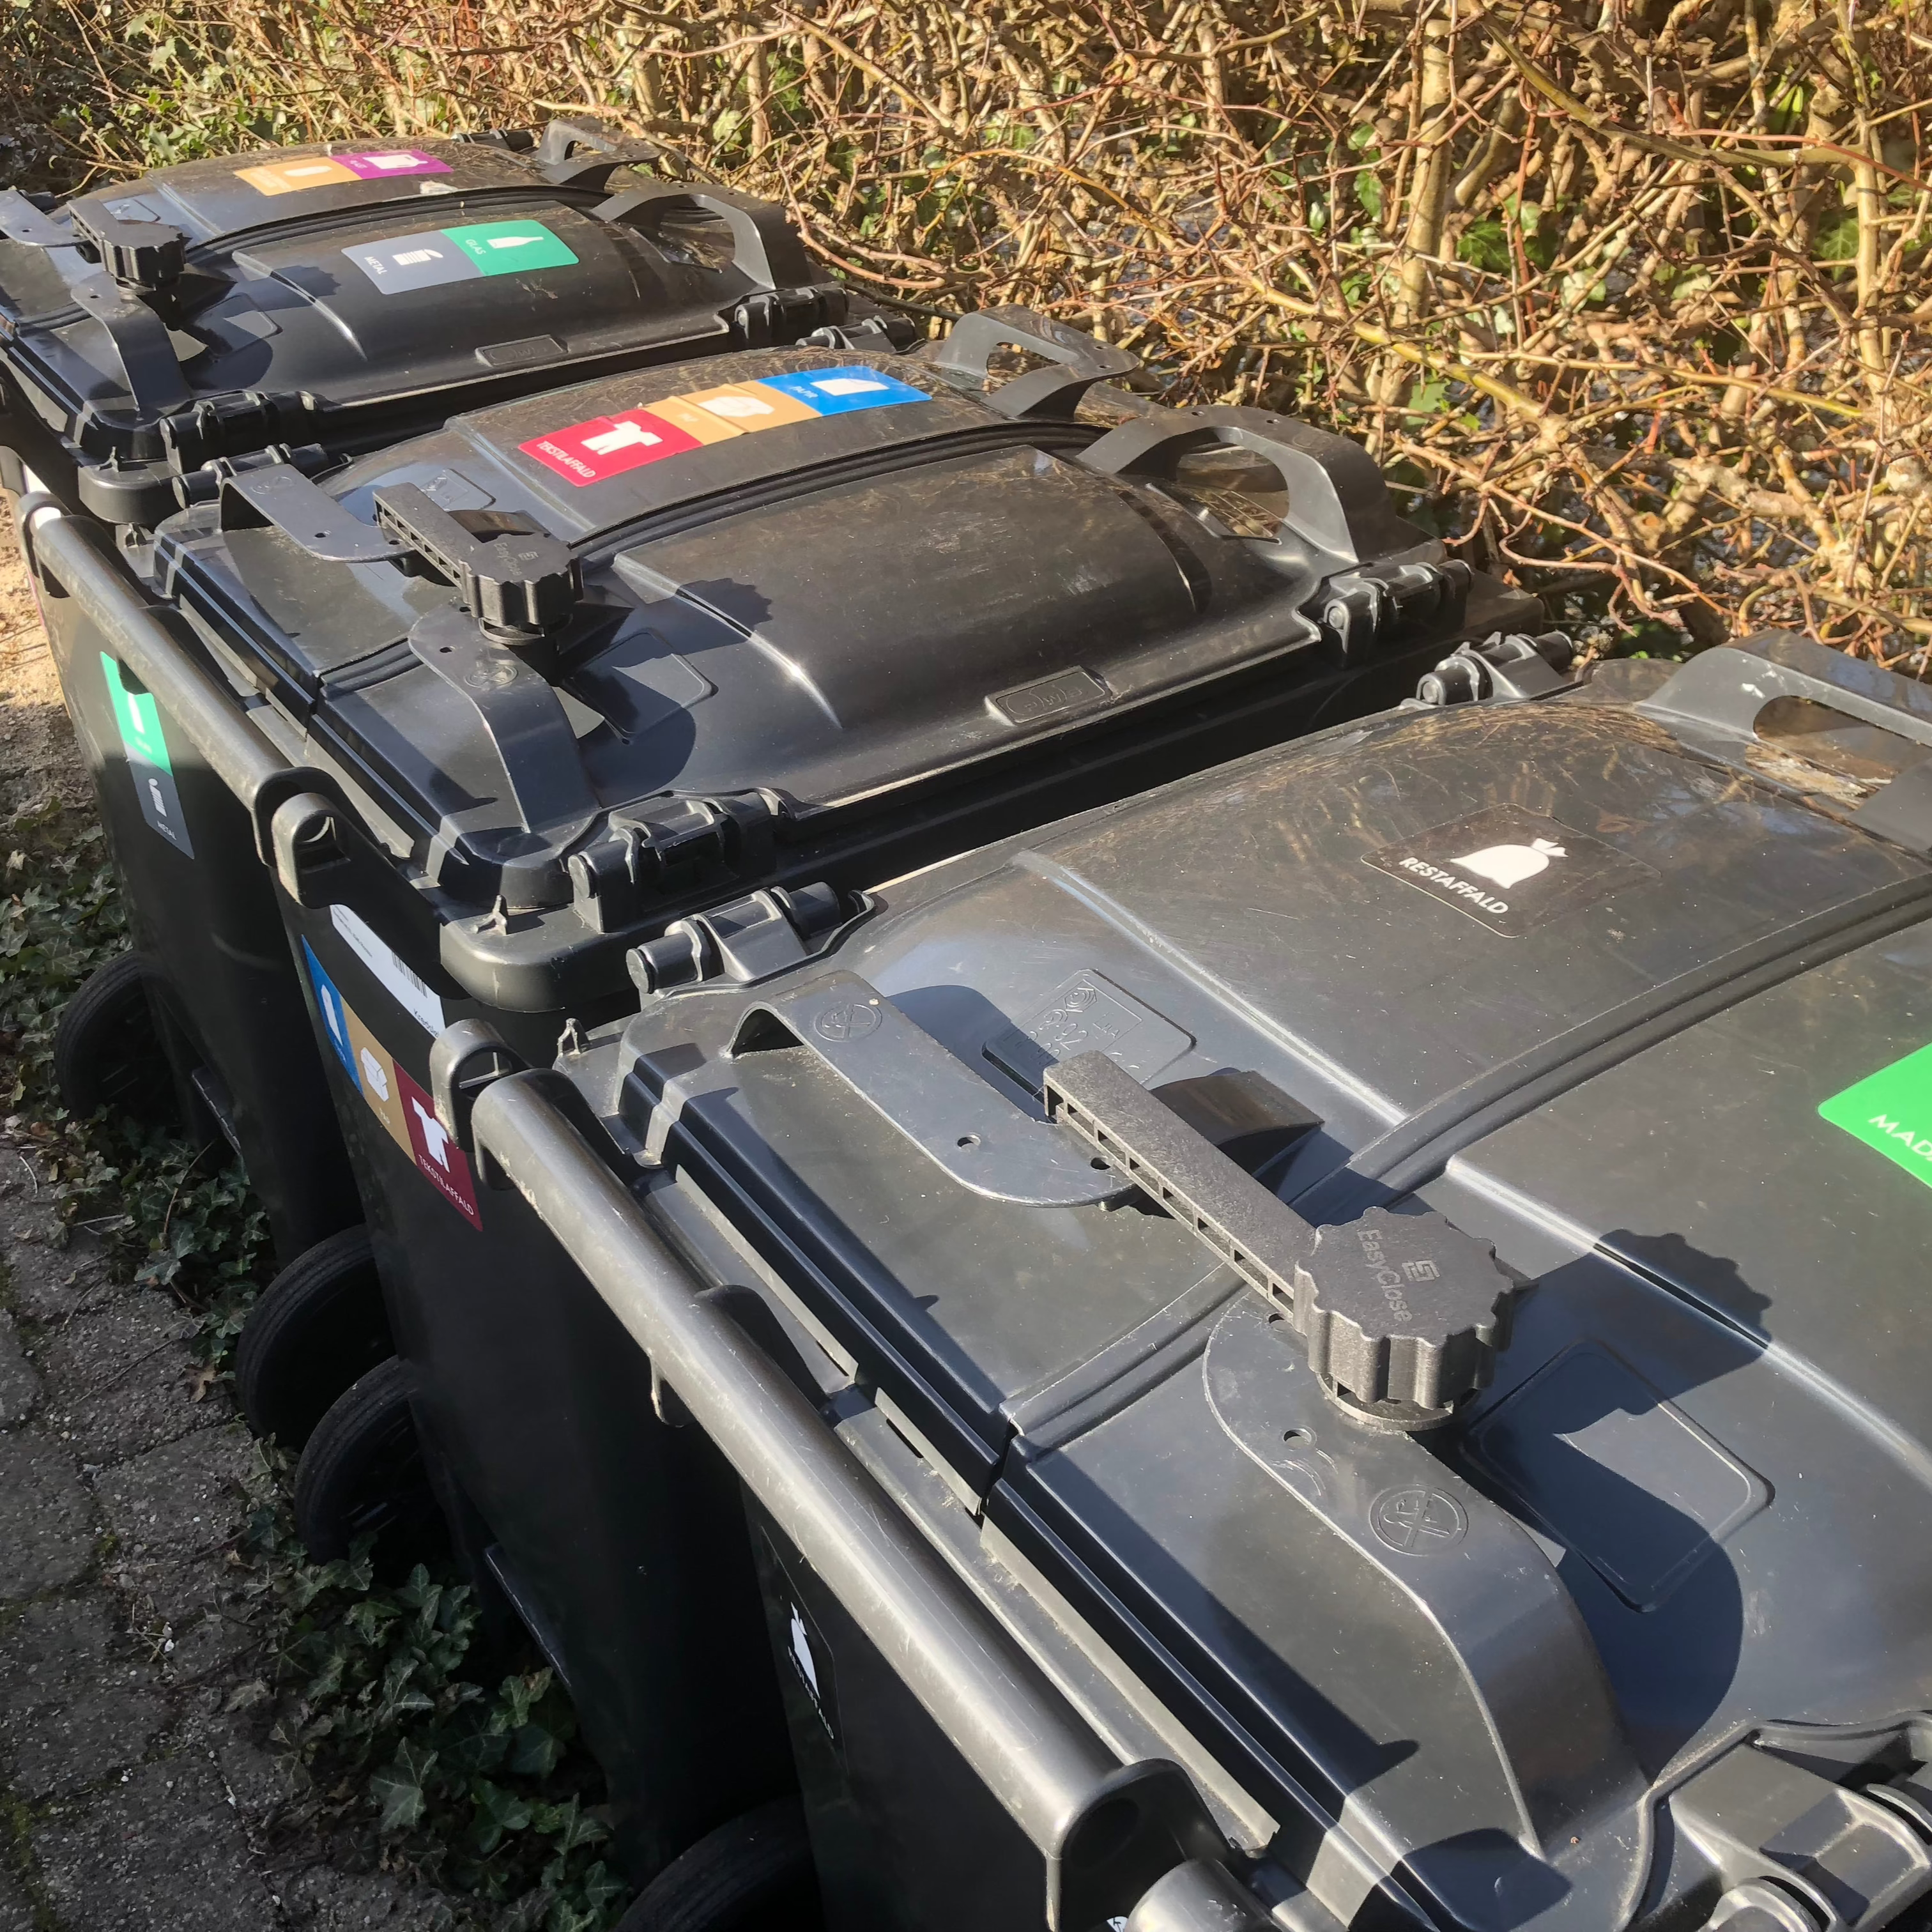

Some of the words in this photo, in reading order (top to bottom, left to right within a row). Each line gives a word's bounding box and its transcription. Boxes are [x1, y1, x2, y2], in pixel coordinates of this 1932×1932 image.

[364, 256, 388, 275] METAL
[465, 238, 486, 255] GLAS
[537, 440, 597, 478] TEKSTILAFFALD
[1399, 856, 1509, 914] RESTAFFALD
[1357, 1229, 1413, 1322] EasyClose
